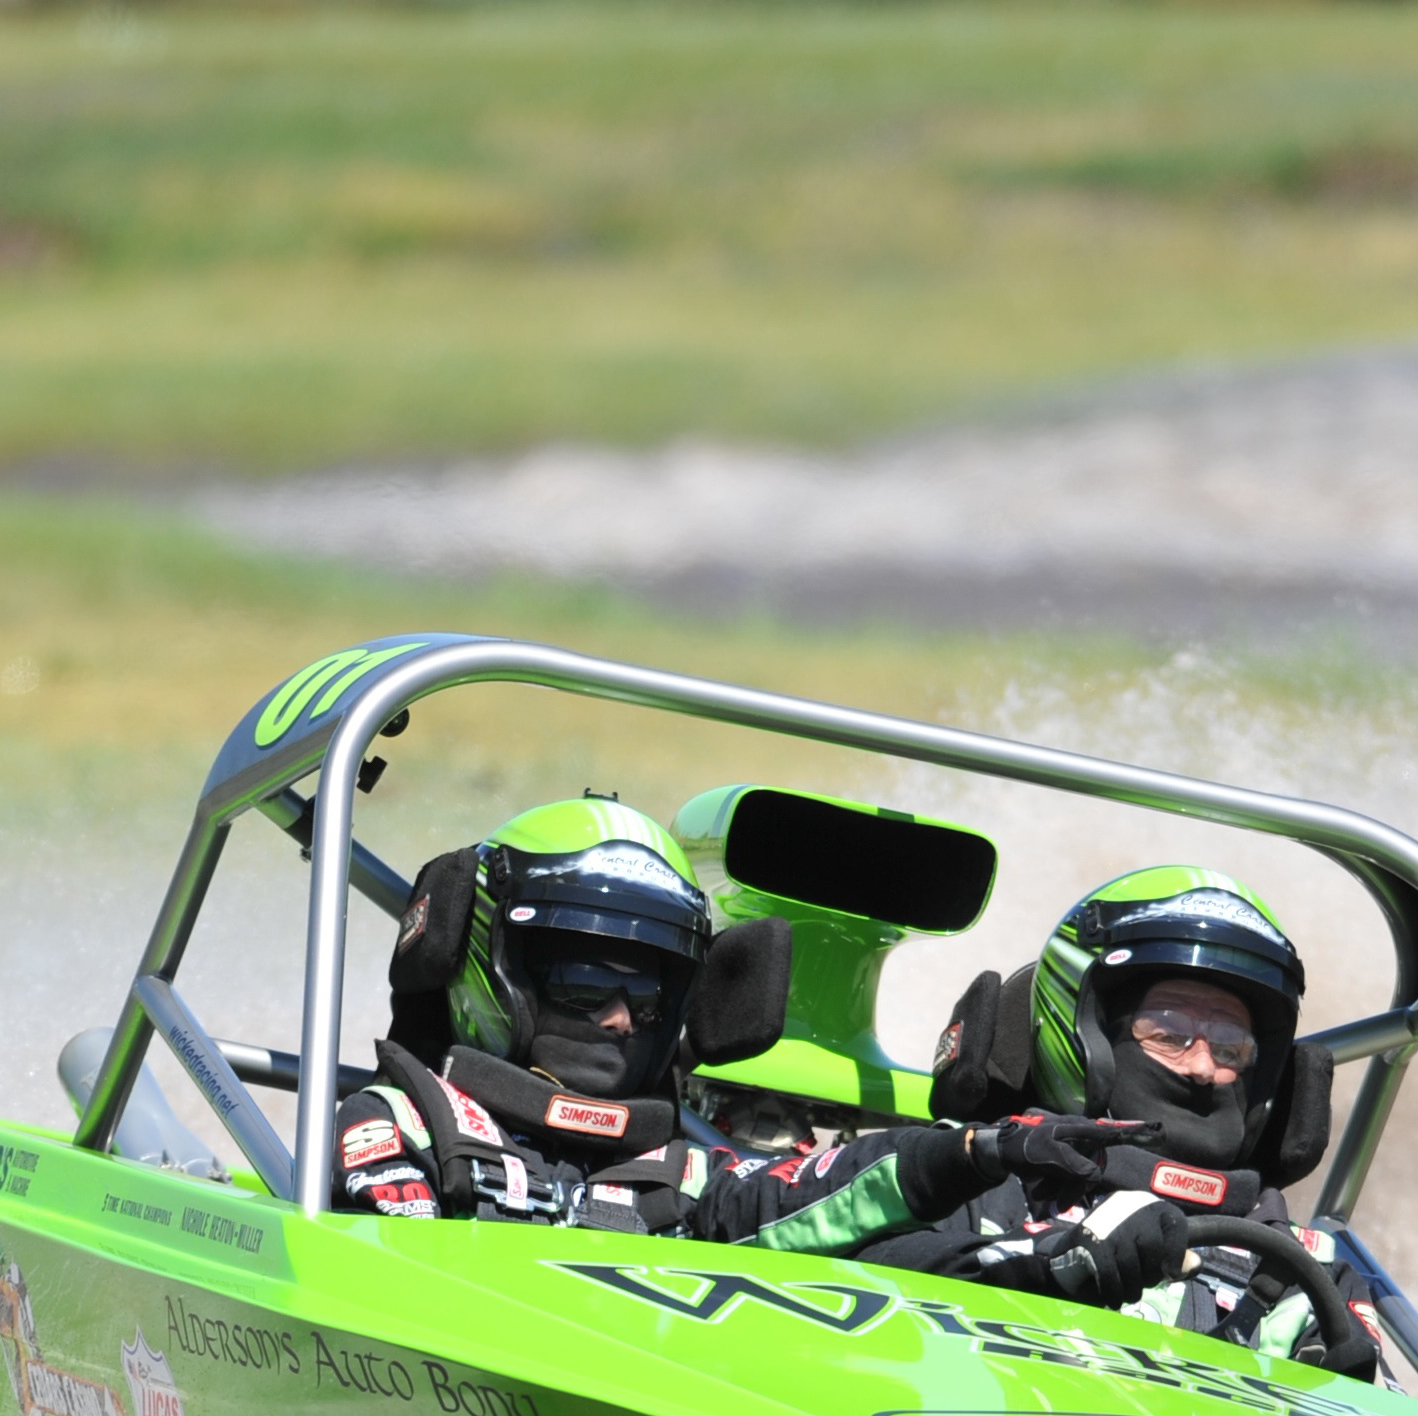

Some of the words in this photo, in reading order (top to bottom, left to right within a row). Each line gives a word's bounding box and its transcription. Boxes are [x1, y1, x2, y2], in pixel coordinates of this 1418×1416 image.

[558, 1106, 618, 1129] SIMPSON
[347, 1140, 396, 1164] SIMPSON
[1161, 1172, 1218, 1197] SIMPSON
